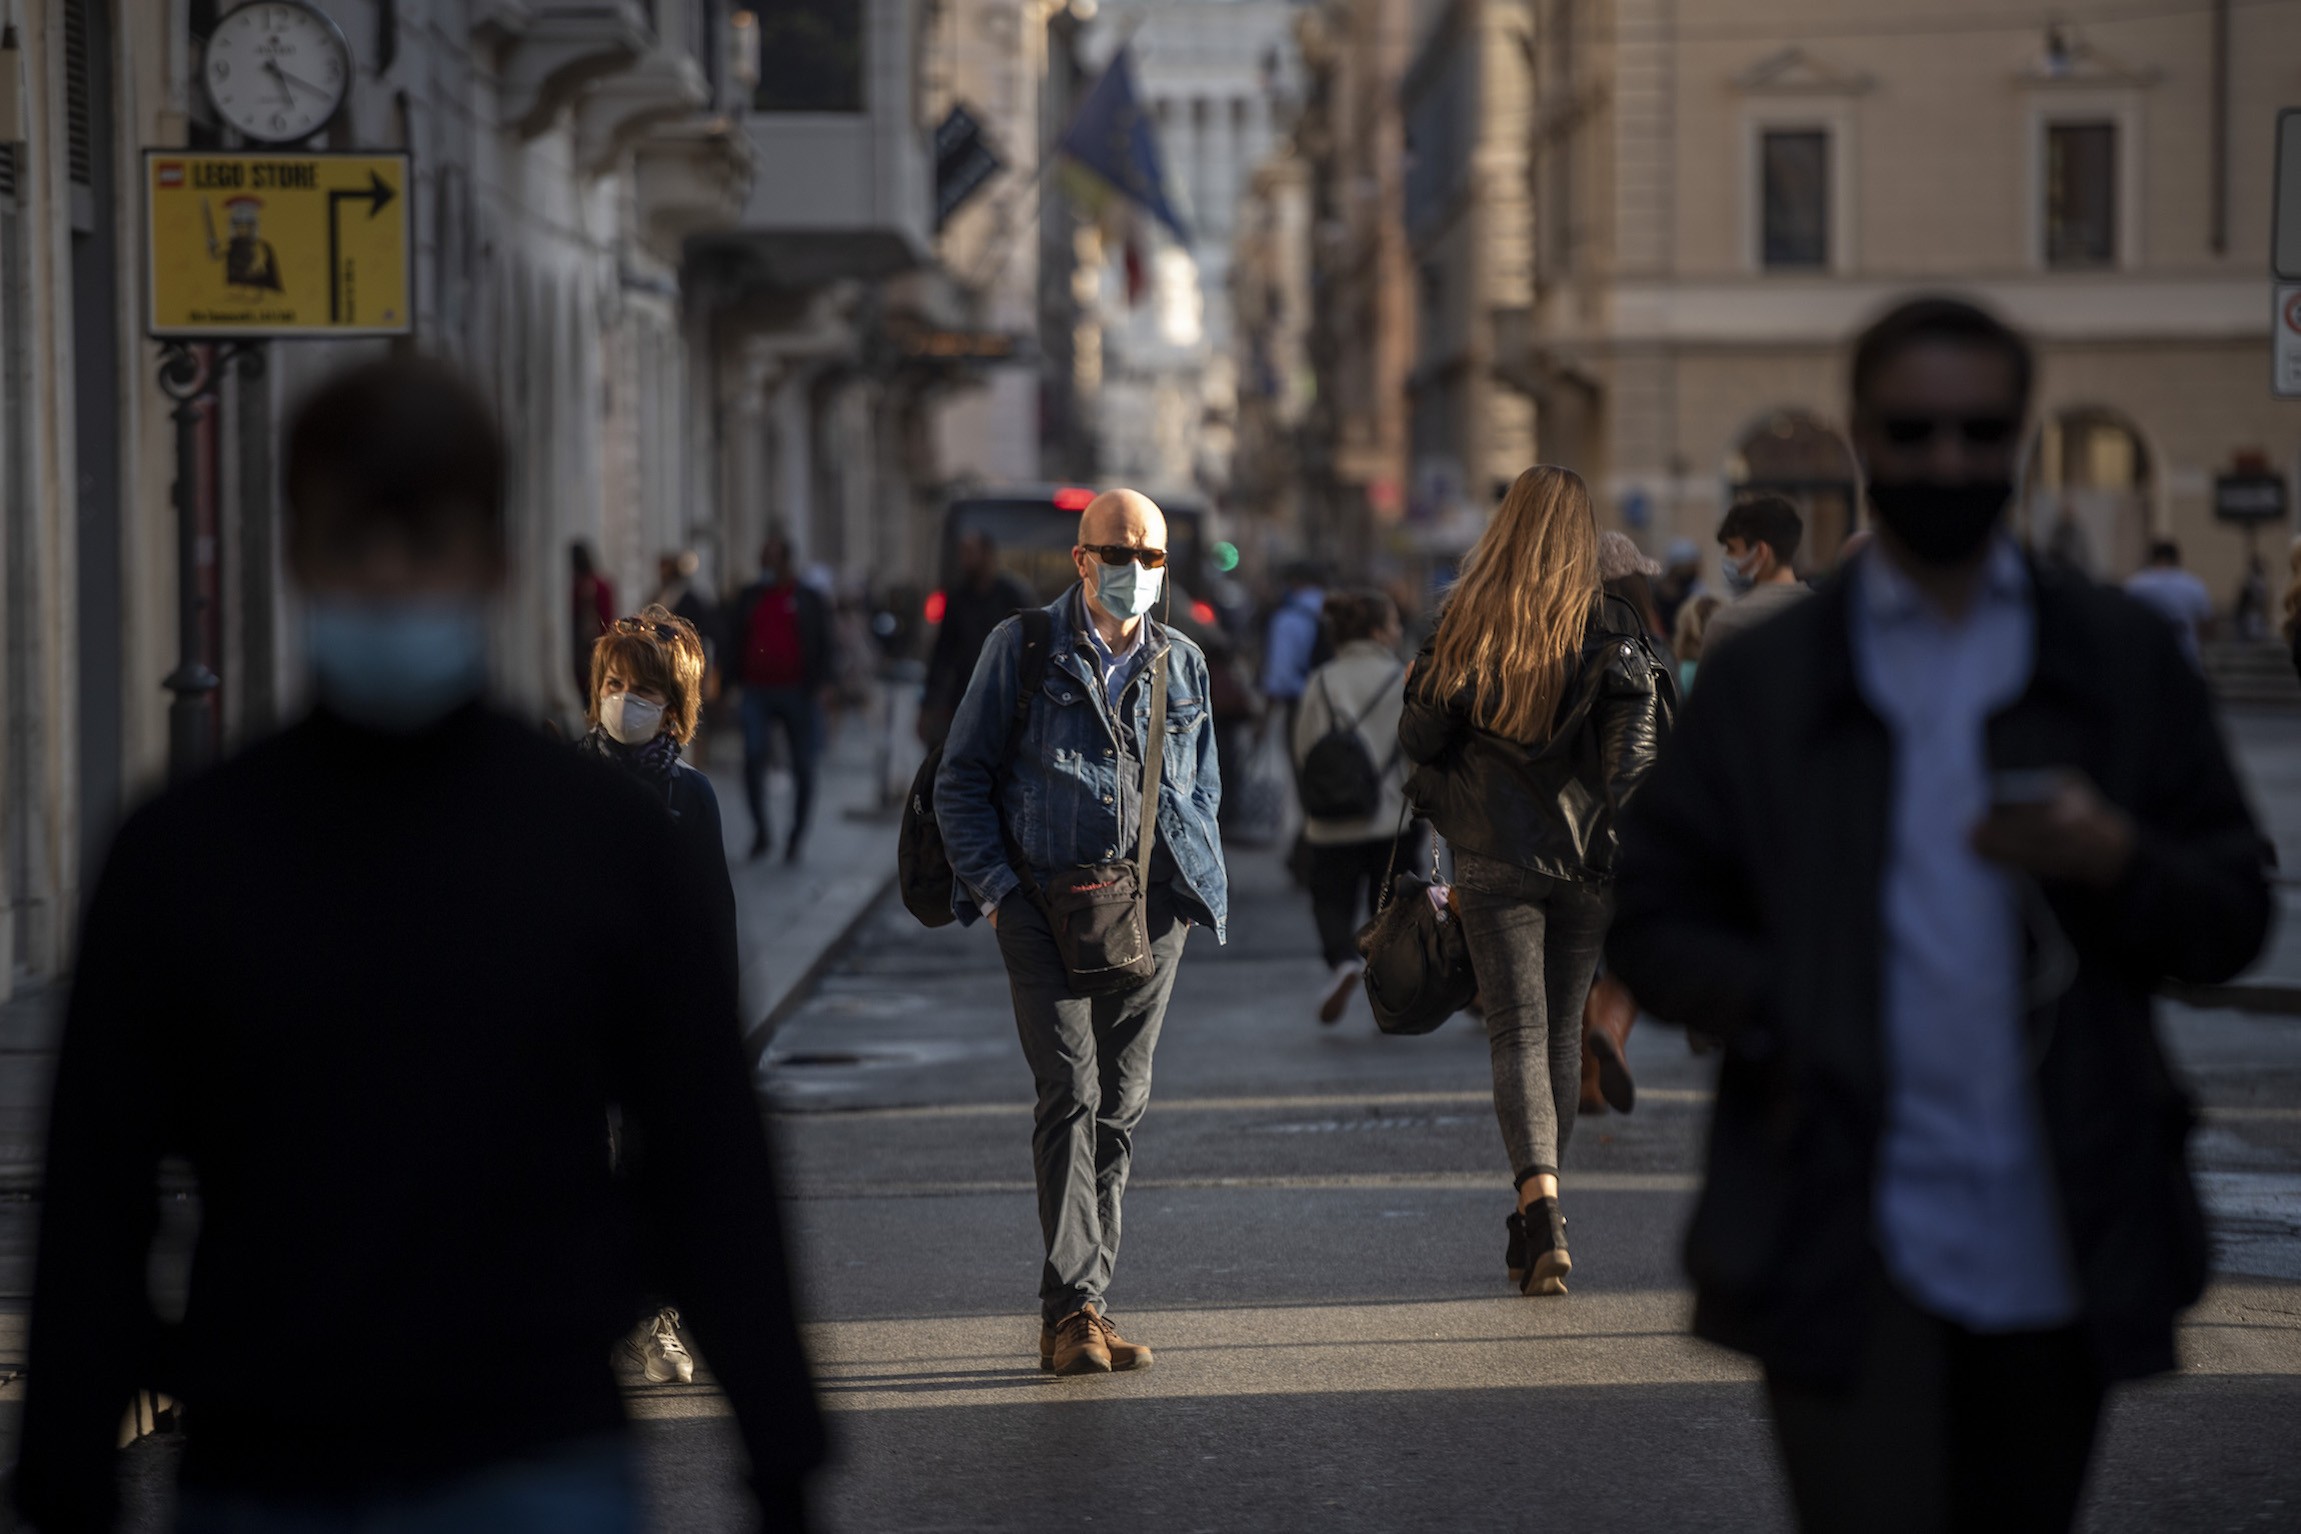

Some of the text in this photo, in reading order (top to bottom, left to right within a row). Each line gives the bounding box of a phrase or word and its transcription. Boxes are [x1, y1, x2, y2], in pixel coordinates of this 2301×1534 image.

[262, 8, 289, 32] 12
[215, 58, 230, 82] 9
[269, 112, 287, 133] 6
[194, 163, 243, 188] LEGO
[252, 163, 317, 188] STORE
